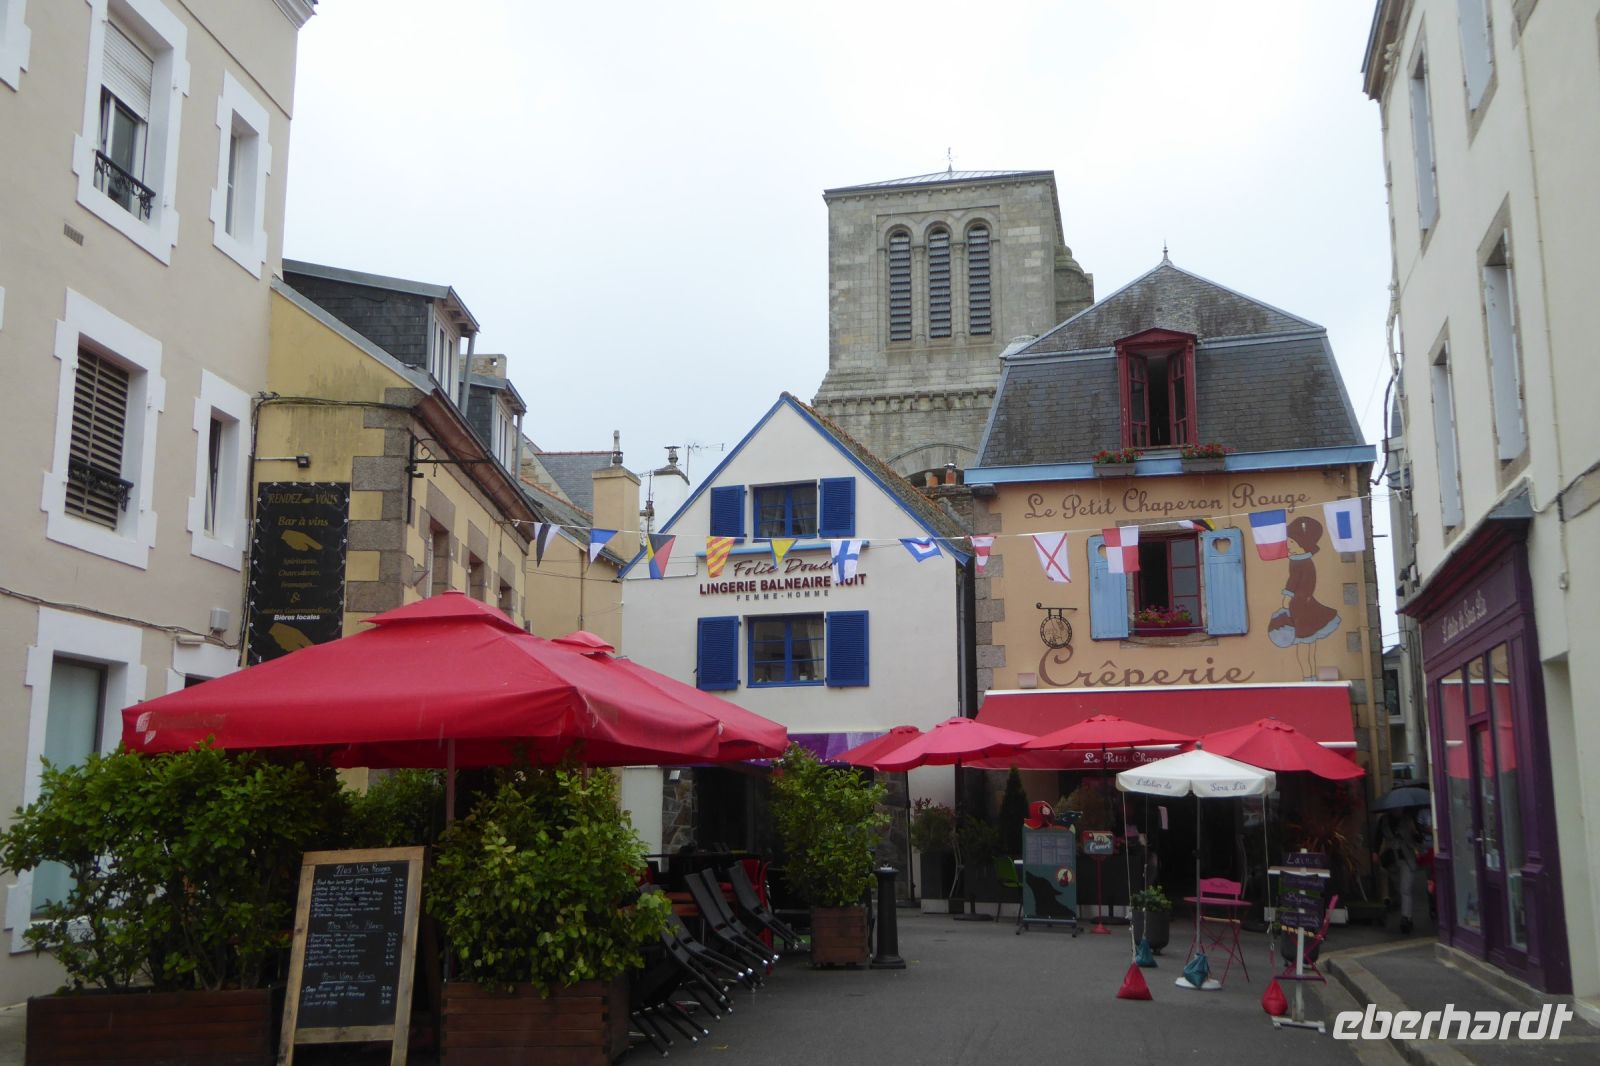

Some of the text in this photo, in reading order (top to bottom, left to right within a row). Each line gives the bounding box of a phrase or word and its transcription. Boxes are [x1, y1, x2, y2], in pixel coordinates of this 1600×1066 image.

[268, 493, 338, 504] RENDEZ VOUS
[1024, 482, 1312, 519] Le Petit Chaperon Rouge
[277, 516, 329, 526] Bar à vins
[733, 560, 779, 577] Folie
[699, 573, 867, 595] LINGERIE BALNEAIRE UIT
[290, 591, 301, 603] &
[1038, 646, 1255, 687] Crêperie
[1083, 752, 1101, 764] Le
[1104, 752, 1129, 764] Petit
